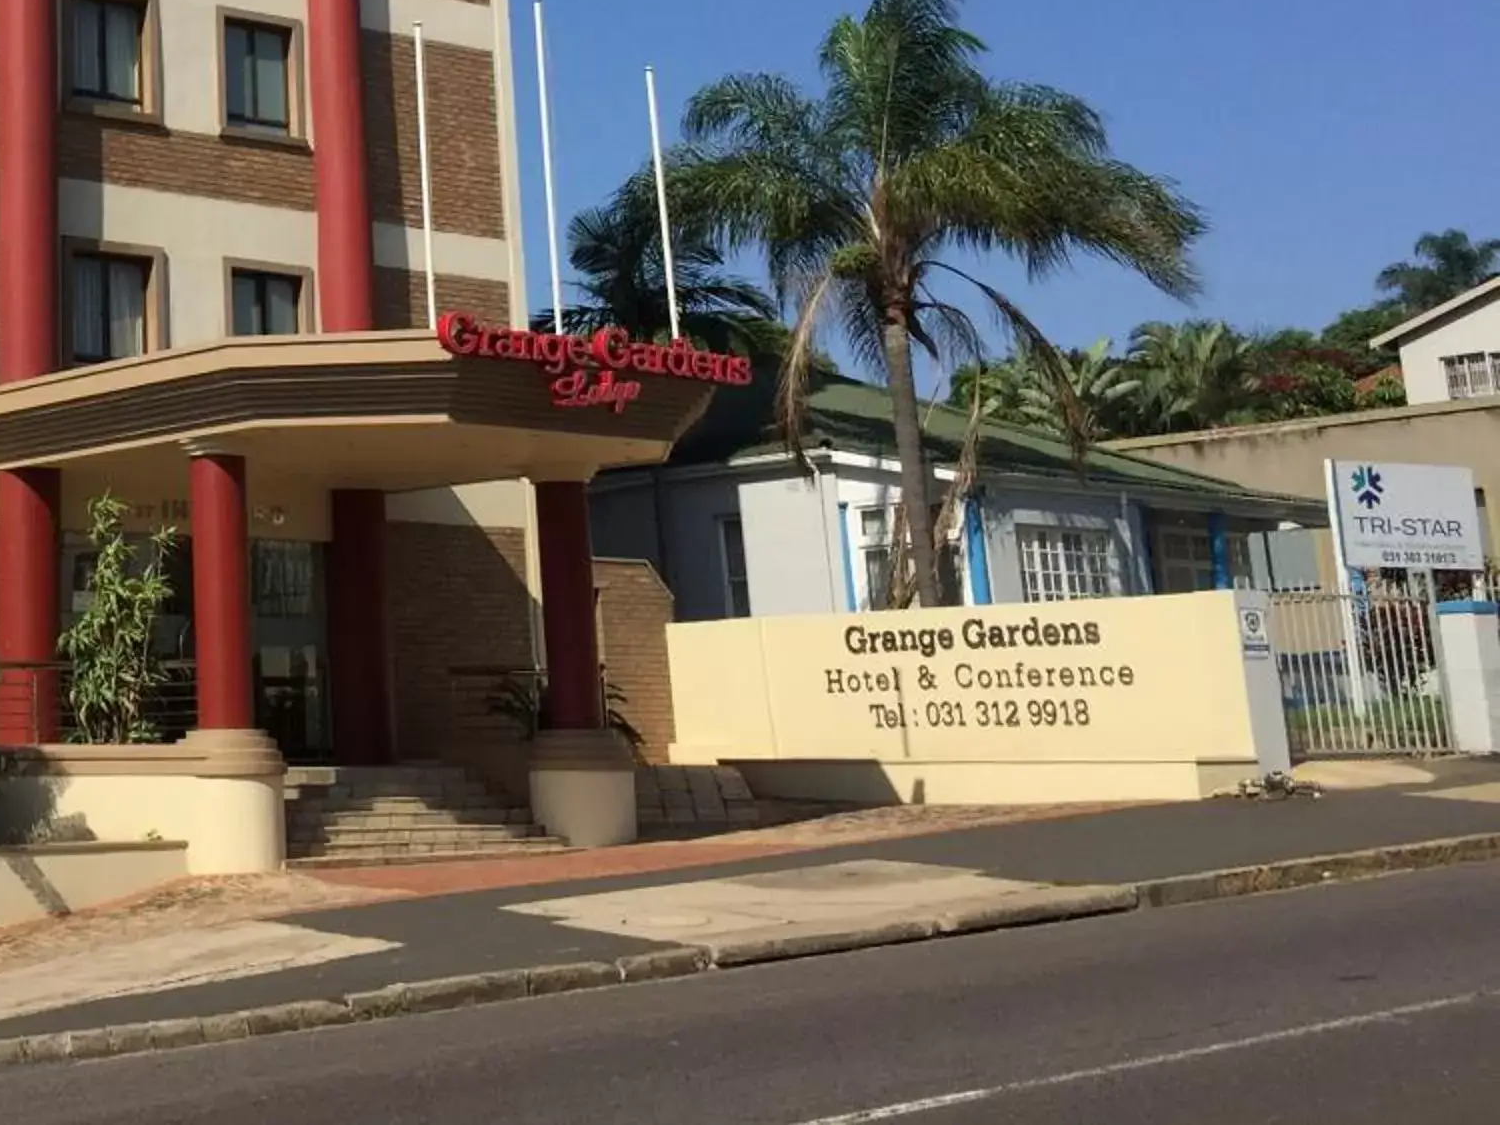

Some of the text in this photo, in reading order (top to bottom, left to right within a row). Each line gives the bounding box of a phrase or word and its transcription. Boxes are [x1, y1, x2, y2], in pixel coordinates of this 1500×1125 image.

[436, 310, 753, 385] Grange Gardens
[550, 371, 643, 413] Lodge
[1353, 516, 1463, 537] TRI-STAR
[844, 616, 1101, 657] Grange Gardens
[824, 662, 1135, 694] Hotel & Conference
[925, 701, 967, 727] 031
[975, 700, 1021, 727] 312
[1027, 698, 1091, 726] 9918
